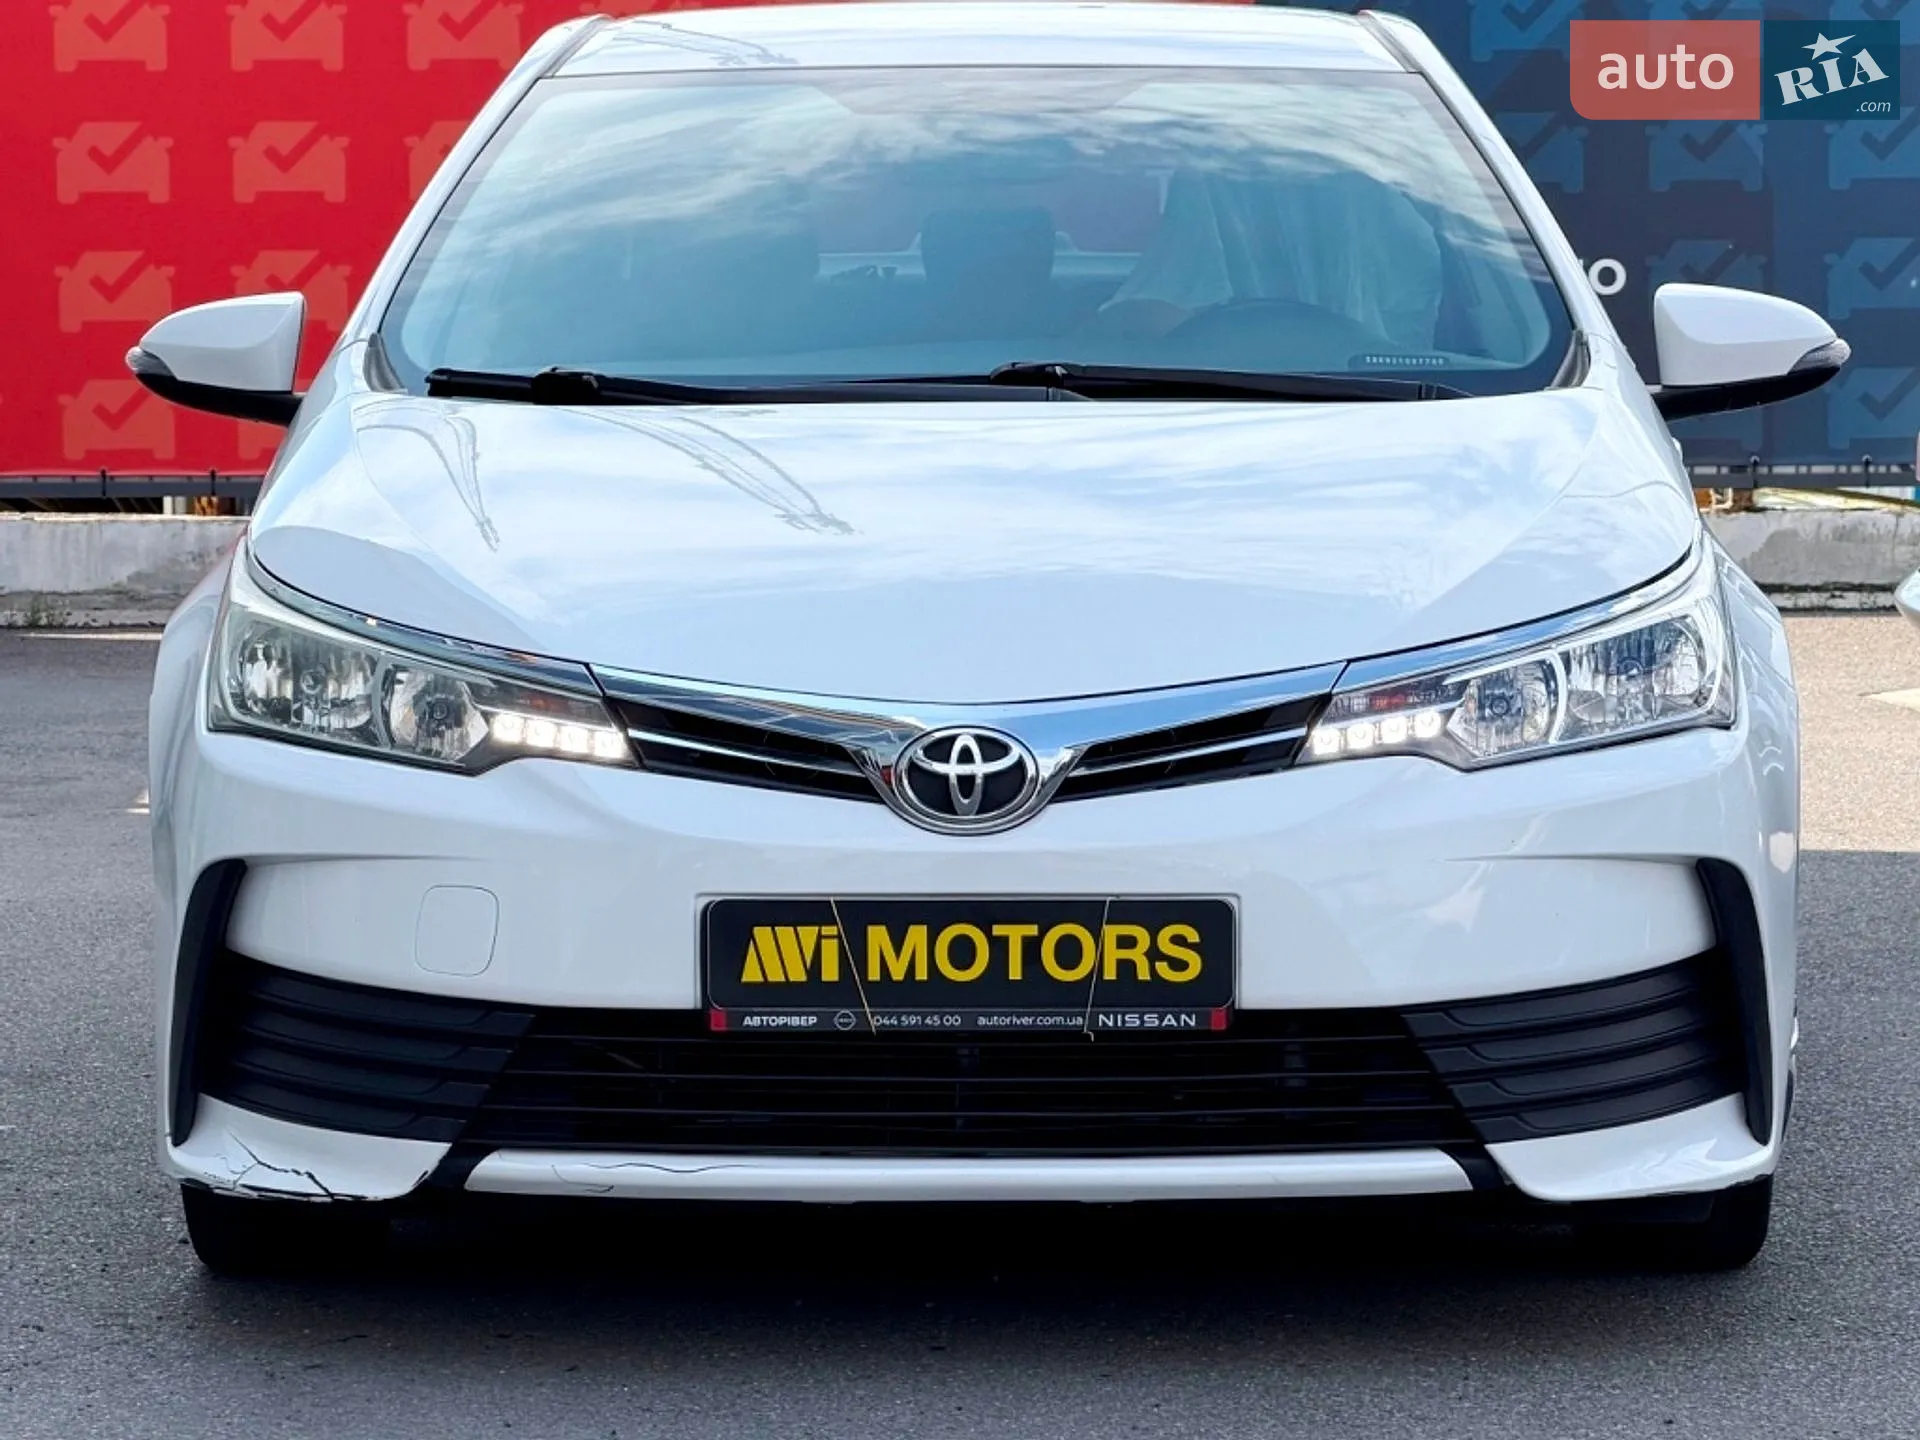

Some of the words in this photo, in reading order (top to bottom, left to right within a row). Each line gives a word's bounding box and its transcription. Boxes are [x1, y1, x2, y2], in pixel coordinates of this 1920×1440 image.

[867, 923, 1202, 982] MOTORS
[743, 1016, 817, 1026] АВТОРІВЕР
[874, 1015, 898, 1026] 044
[901, 1015, 922, 1026] 591
[925, 1015, 941, 1026] 45
[943, 1015, 961, 1026] 00
[977, 1014, 1083, 1026] autoriver.com.ua
[1098, 1014, 1196, 1027] NISSAN
